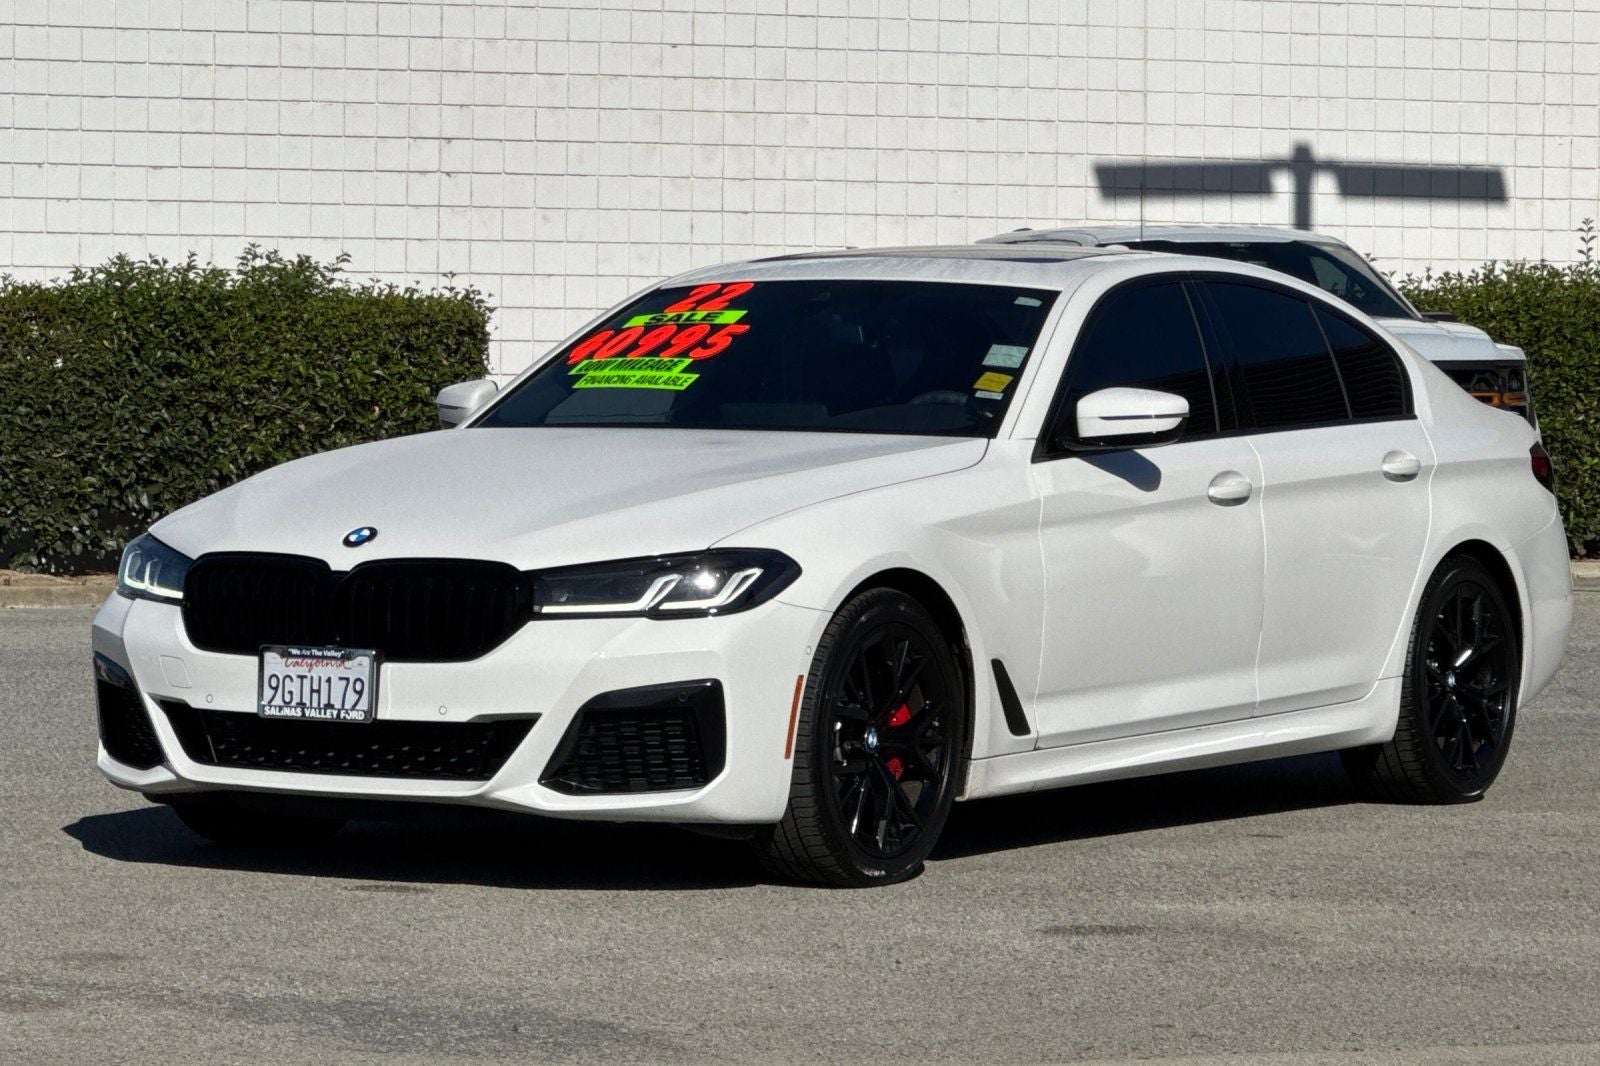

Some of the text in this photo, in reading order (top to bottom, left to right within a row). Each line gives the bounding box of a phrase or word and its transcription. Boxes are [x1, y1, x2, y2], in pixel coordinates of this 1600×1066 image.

[664, 282, 755, 312] 22
[645, 312, 726, 325] SALE
[567, 324, 751, 364] 40995
[576, 358, 685, 373] LOW MILEAGE
[580, 374, 693, 387] FINANCING AVAILABLE
[311, 649, 323, 657] The
[284, 657, 352, 673] California
[267, 673, 365, 710] 9GIH179
[264, 705, 302, 717] SALINAS
[304, 707, 338, 719] VALLEY
